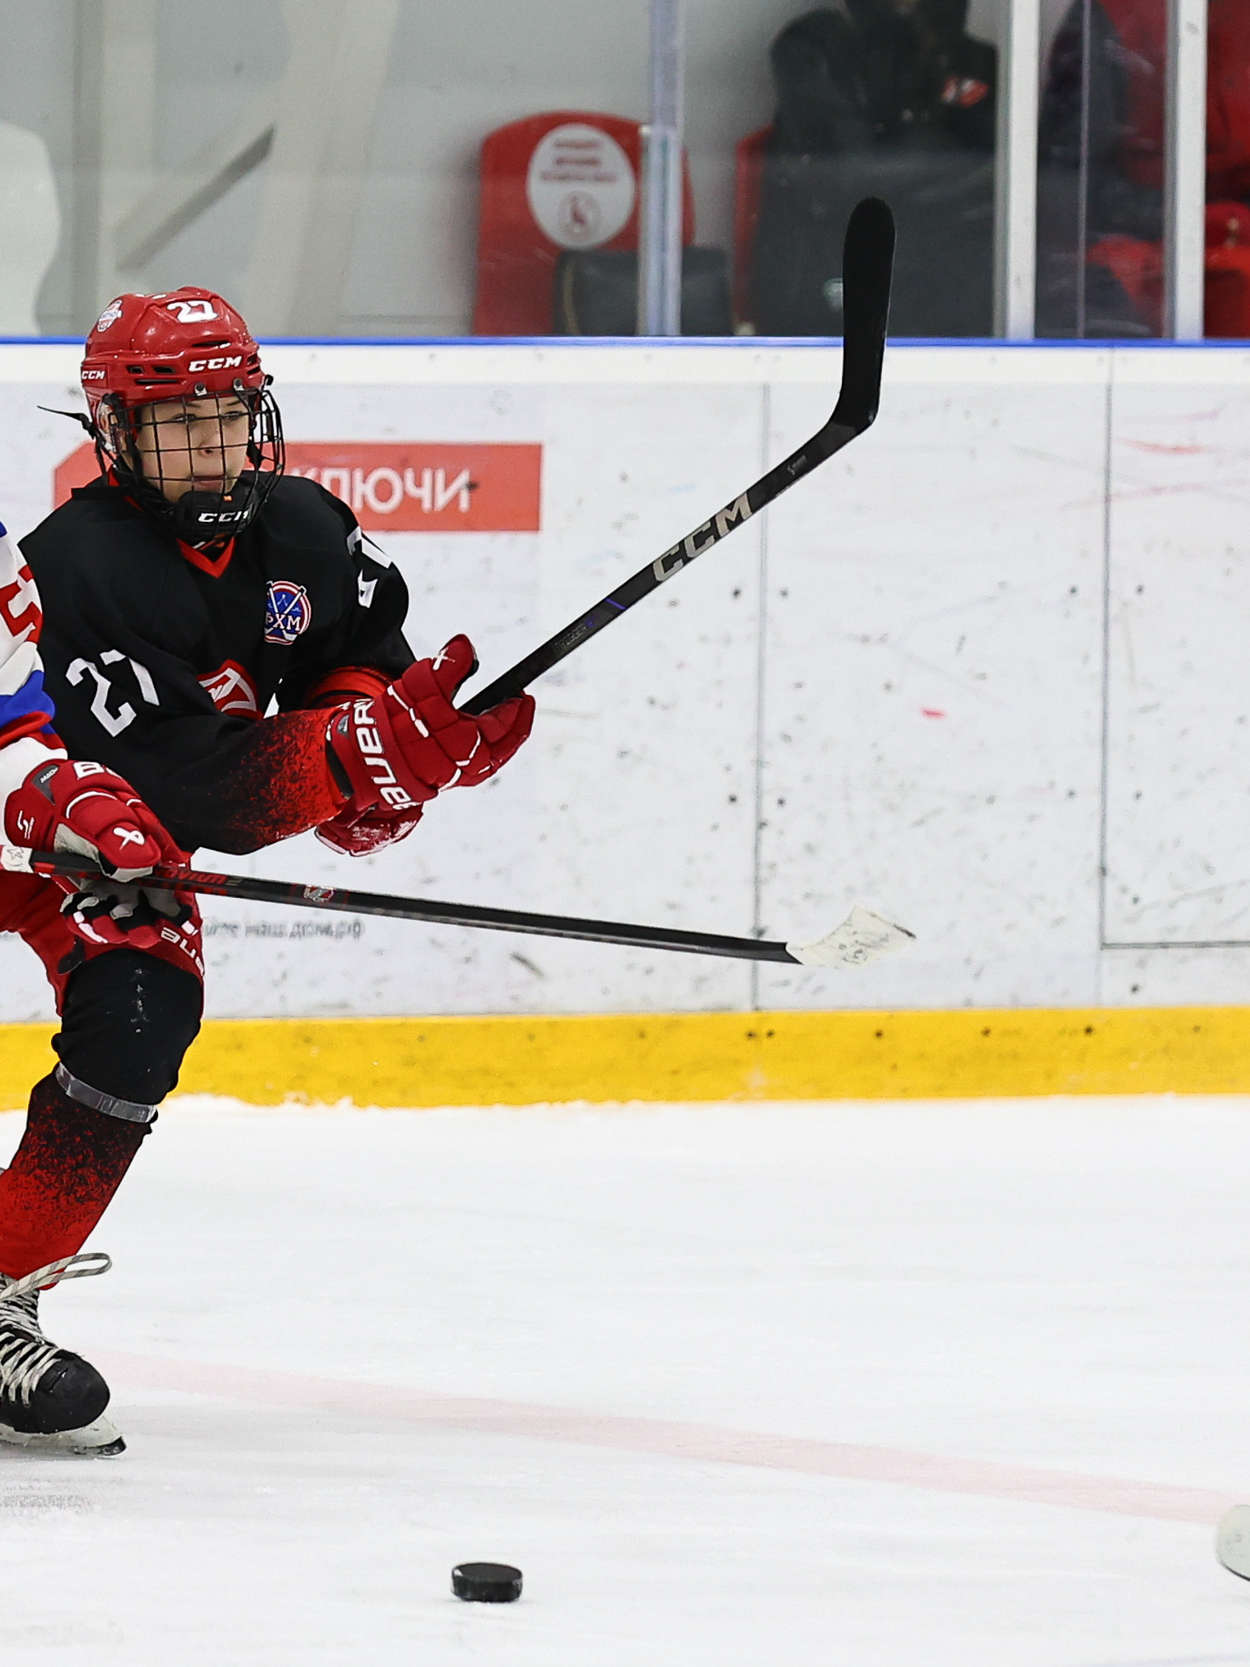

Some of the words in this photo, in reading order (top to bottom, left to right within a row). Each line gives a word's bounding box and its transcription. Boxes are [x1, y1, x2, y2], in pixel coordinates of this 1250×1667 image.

[167, 300, 219, 324] 27
[81, 370, 106, 380] CCM
[188, 356, 243, 372] CCM
[652, 493, 753, 582] CCM
[65, 649, 160, 738] 27
